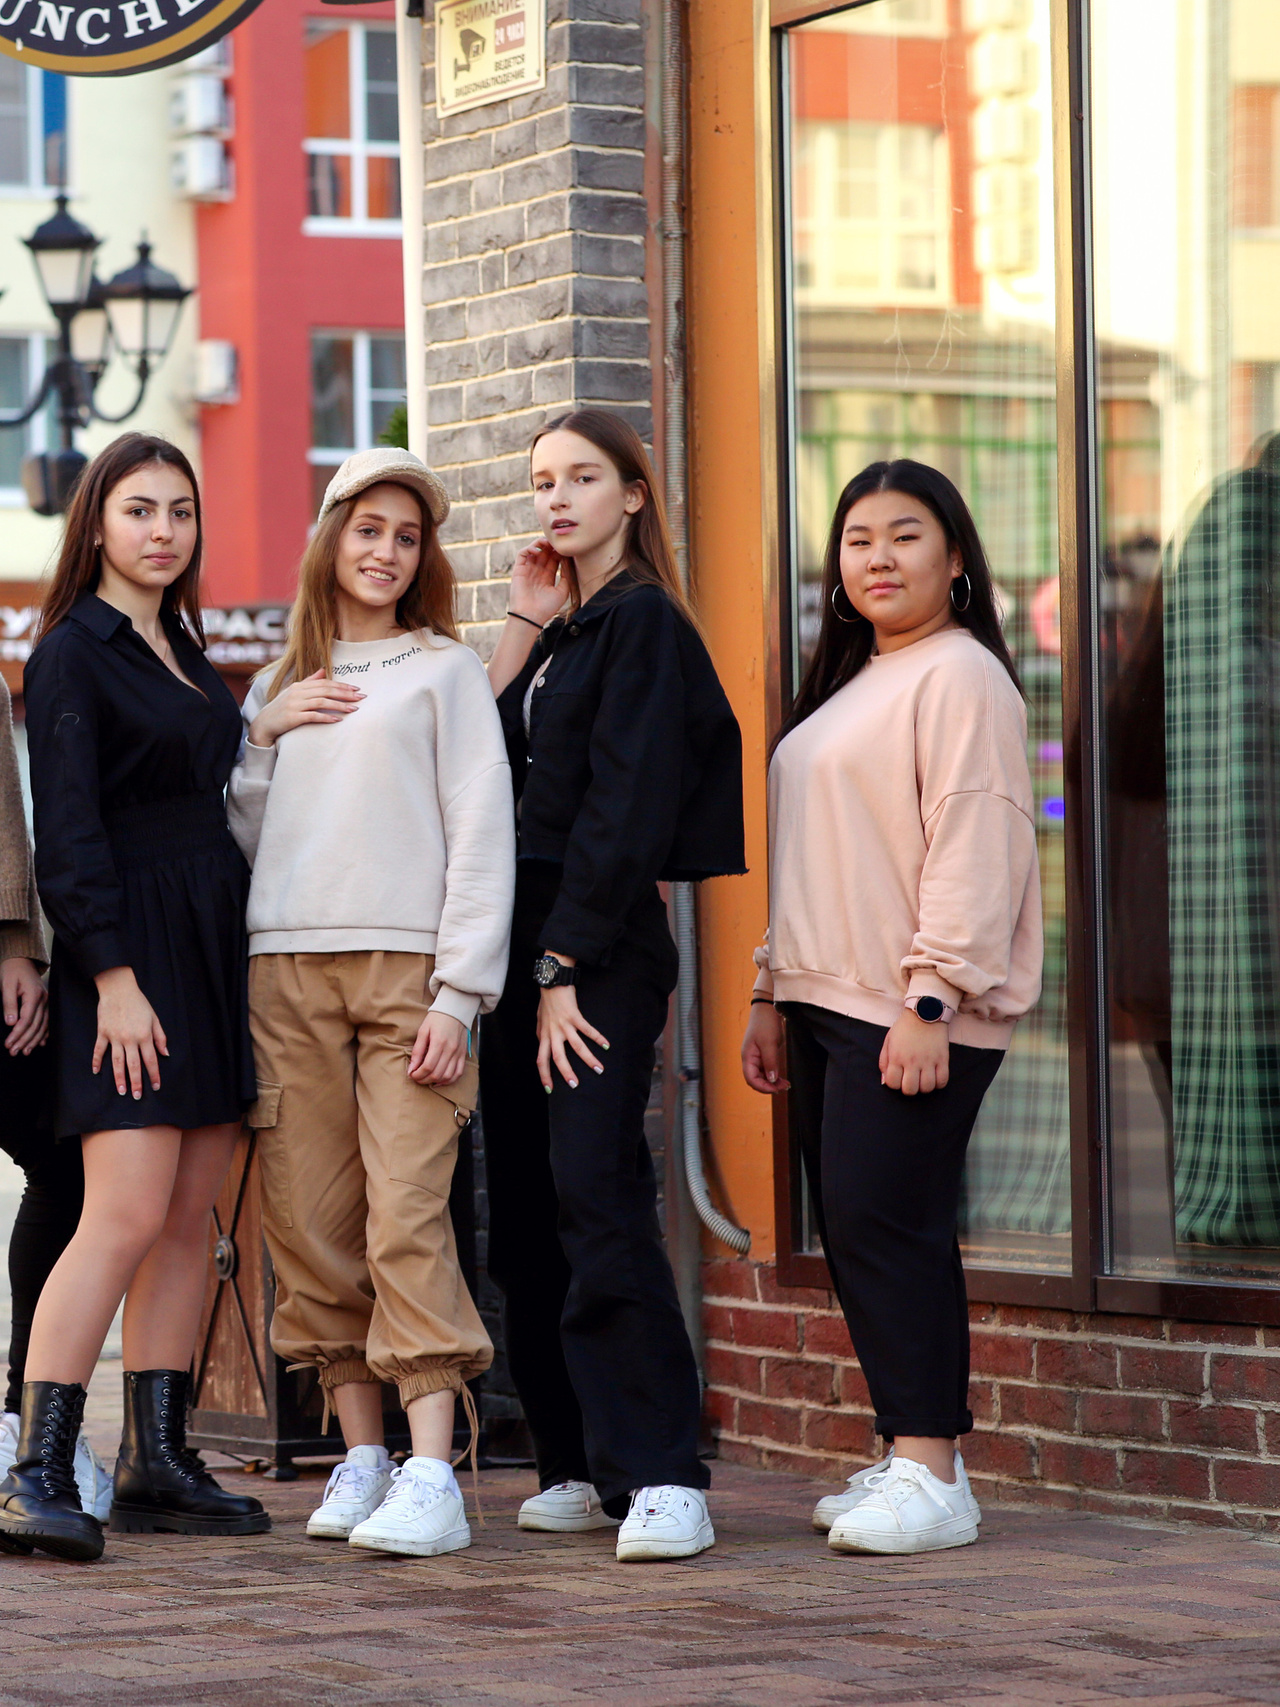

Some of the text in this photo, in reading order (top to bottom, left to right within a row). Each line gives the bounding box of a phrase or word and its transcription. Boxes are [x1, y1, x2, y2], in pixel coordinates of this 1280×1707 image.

[495, 27, 505, 46] 24
[494, 54, 525, 72] ВЕДЕТСЯ
[455, 68, 525, 98] ВИДЕОНАБЛЮДЕНИЕ
